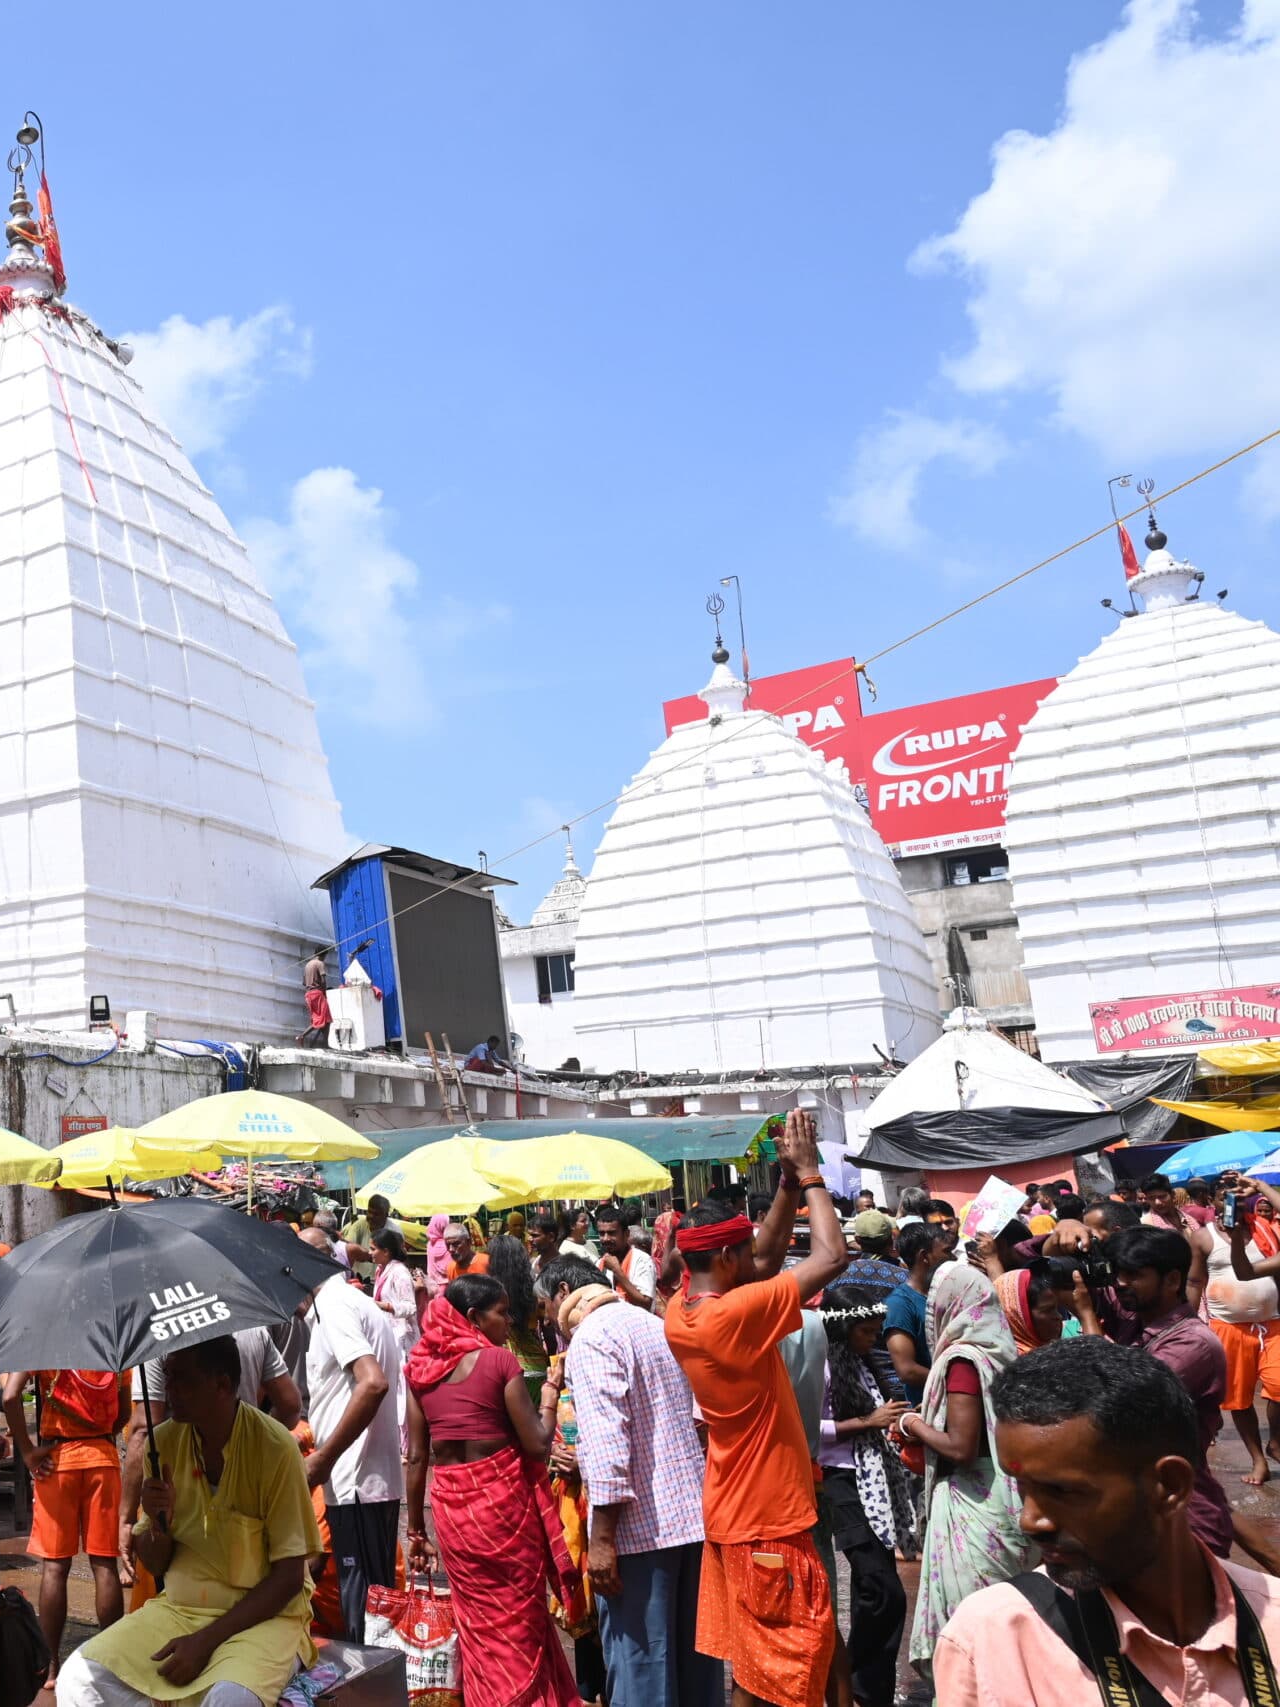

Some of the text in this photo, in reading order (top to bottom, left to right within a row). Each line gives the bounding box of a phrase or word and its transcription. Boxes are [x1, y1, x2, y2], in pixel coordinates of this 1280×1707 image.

[783, 704, 845, 736] PA
[903, 720, 1007, 755] RUPA
[986, 793, 1009, 805] STYL
[1100, 1026, 1114, 1047] श्री
[1111, 1018, 1126, 1040] श्री
[1123, 1011, 1150, 1035] 1008
[1204, 1001, 1233, 1017] बाबा
[1205, 1031, 1225, 1041] सभा
[239, 1123, 293, 1134] STEELS
[245, 1111, 278, 1121] LALL
[150, 1281, 205, 1310] LALL
[150, 1300, 233, 1341] STEELS
[1247, 1647, 1275, 1707] Nikon
